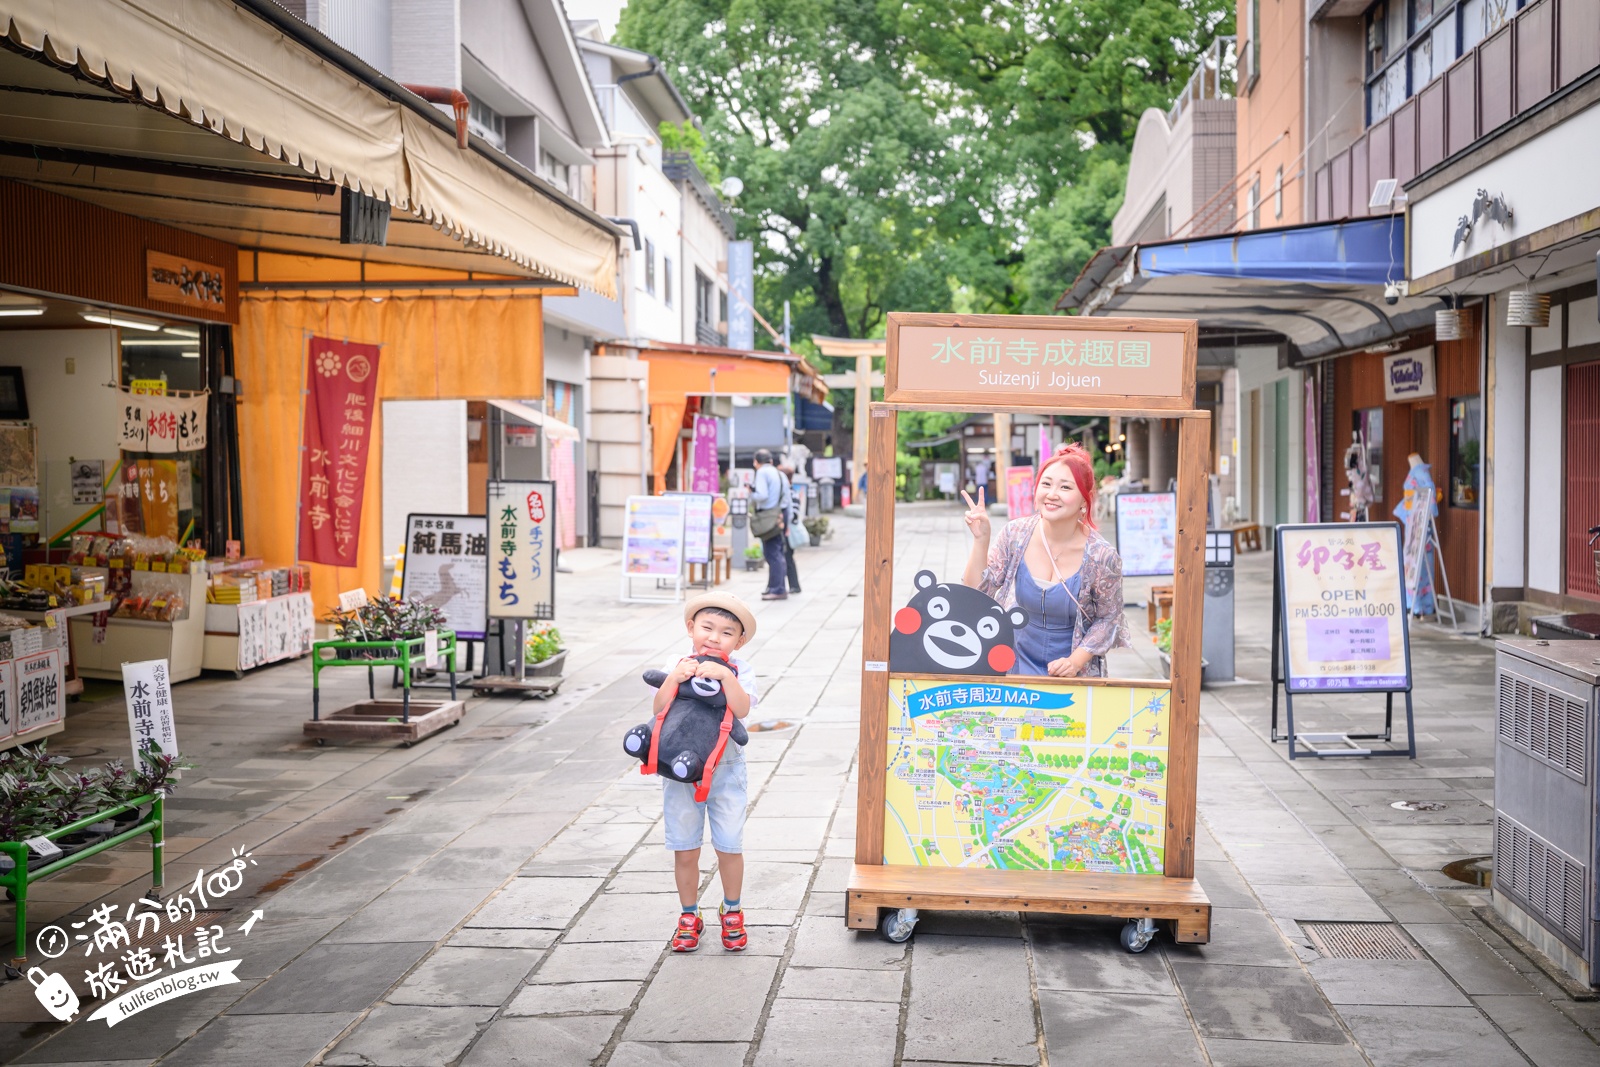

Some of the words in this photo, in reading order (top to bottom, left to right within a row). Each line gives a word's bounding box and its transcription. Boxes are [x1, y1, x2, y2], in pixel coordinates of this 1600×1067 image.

[931, 336, 1151, 368] 水前寺成趣園
[978, 370, 1040, 390] Suizenji
[1048, 371, 1101, 390] Jojuen
[307, 448, 332, 530] 水前寺
[334, 392, 367, 557] 肥後細川文化に会いに行く
[412, 531, 486, 556] 純馬油
[414, 520, 454, 529] 熊本名産
[498, 505, 519, 606] 水前寺もち
[529, 526, 543, 581] 手づくり
[1321, 589, 1366, 601] OPEN
[21, 673, 57, 718] 朝鮮飴
[152, 664, 168, 706] 美容と健康
